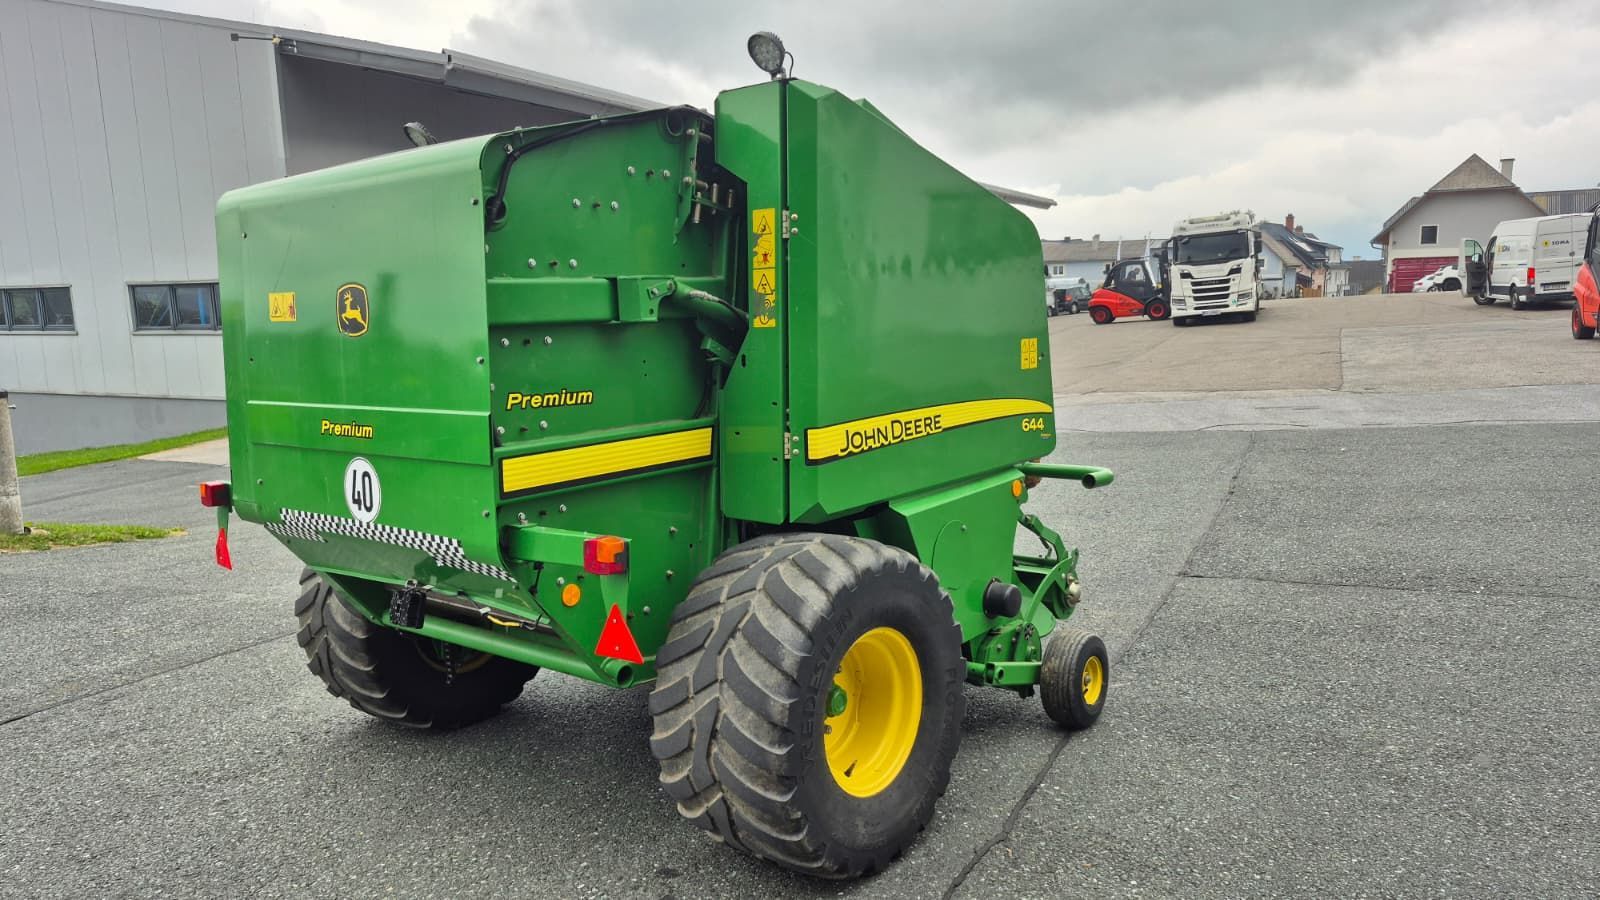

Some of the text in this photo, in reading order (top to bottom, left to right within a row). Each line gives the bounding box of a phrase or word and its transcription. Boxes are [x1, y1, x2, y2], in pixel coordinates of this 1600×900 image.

[506, 389, 594, 411] Premium
[320, 419, 374, 440] Premium
[839, 413, 942, 454] JOHN DEERE
[1021, 417, 1045, 432] 644
[351, 470, 374, 513] 40
